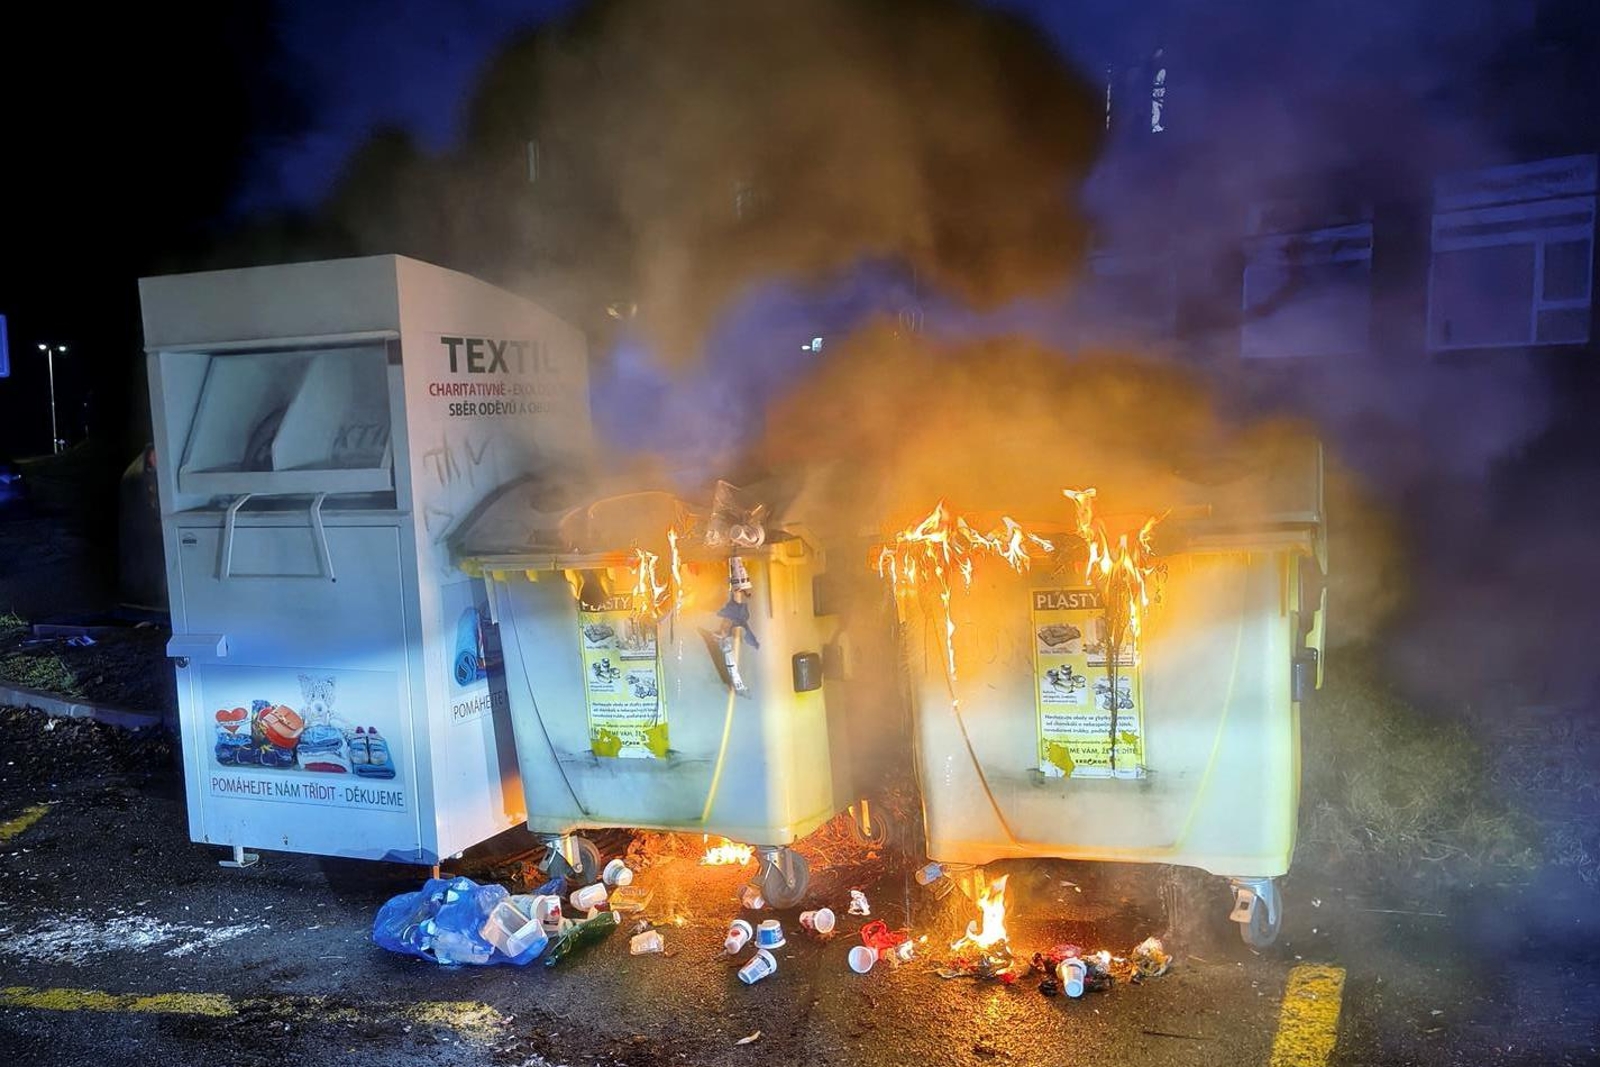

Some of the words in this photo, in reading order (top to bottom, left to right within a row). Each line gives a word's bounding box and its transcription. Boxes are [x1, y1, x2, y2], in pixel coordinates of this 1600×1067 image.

[441, 336, 560, 374] TEXTIL
[429, 381, 505, 397] CHARITATIVNĚ
[449, 401, 477, 416] SBĚR
[479, 400, 516, 415] ODĚVŮ
[1036, 593, 1100, 609] PLASTY
[453, 691, 503, 720] POMÁHEJTE
[212, 776, 272, 797] POMÁHEJTE
[275, 779, 300, 798] NÁM
[302, 783, 336, 801] TŘÍDIT
[345, 786, 404, 807] DĚKUJEME
